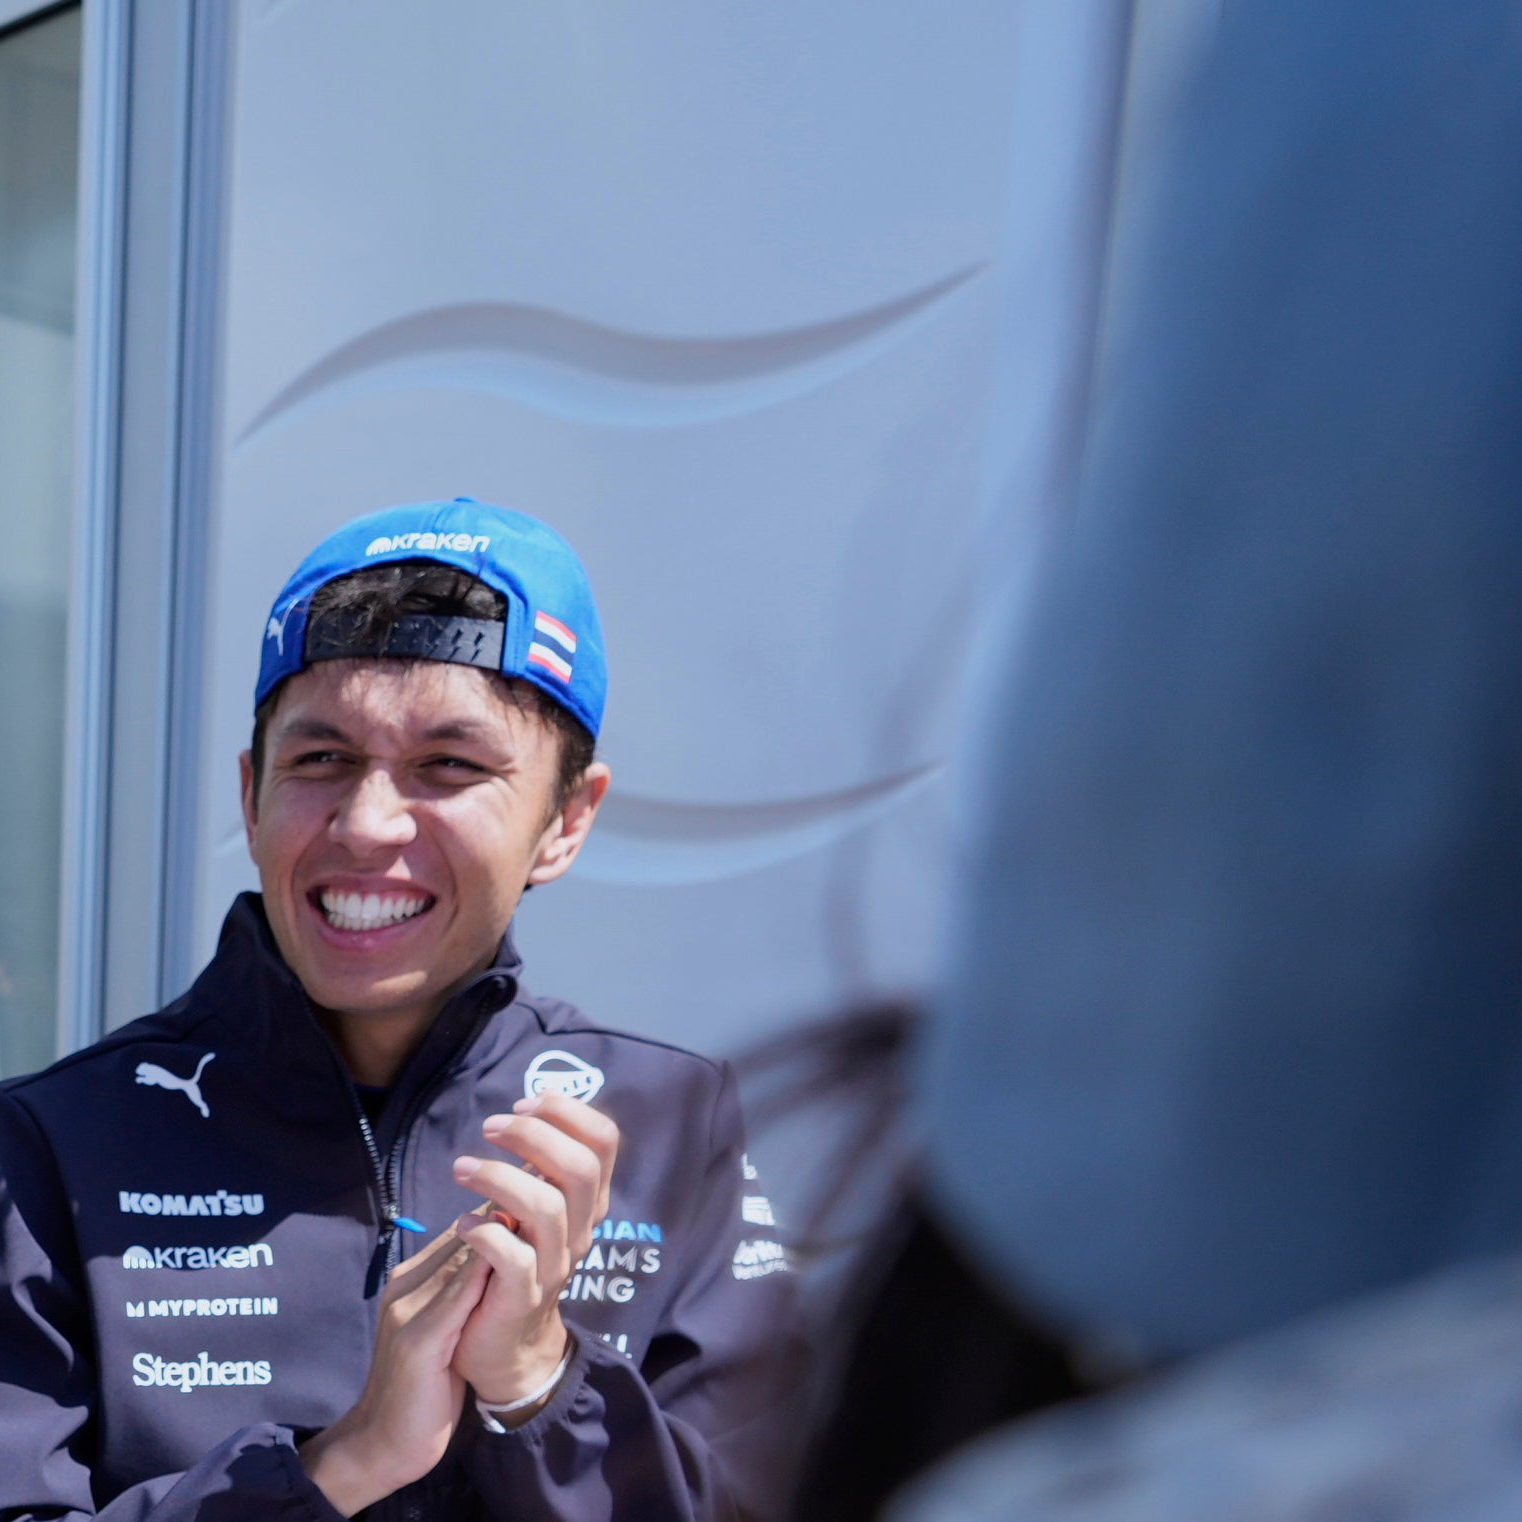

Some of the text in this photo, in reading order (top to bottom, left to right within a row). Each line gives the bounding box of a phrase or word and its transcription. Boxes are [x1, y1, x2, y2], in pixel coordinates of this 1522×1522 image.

[391, 531, 492, 553] kraken
[119, 1190, 264, 1216] KOMATSU
[154, 1242, 274, 1269] kraken
[148, 1297, 279, 1318] MYPROTEIN
[131, 1351, 273, 1394] Stephens
